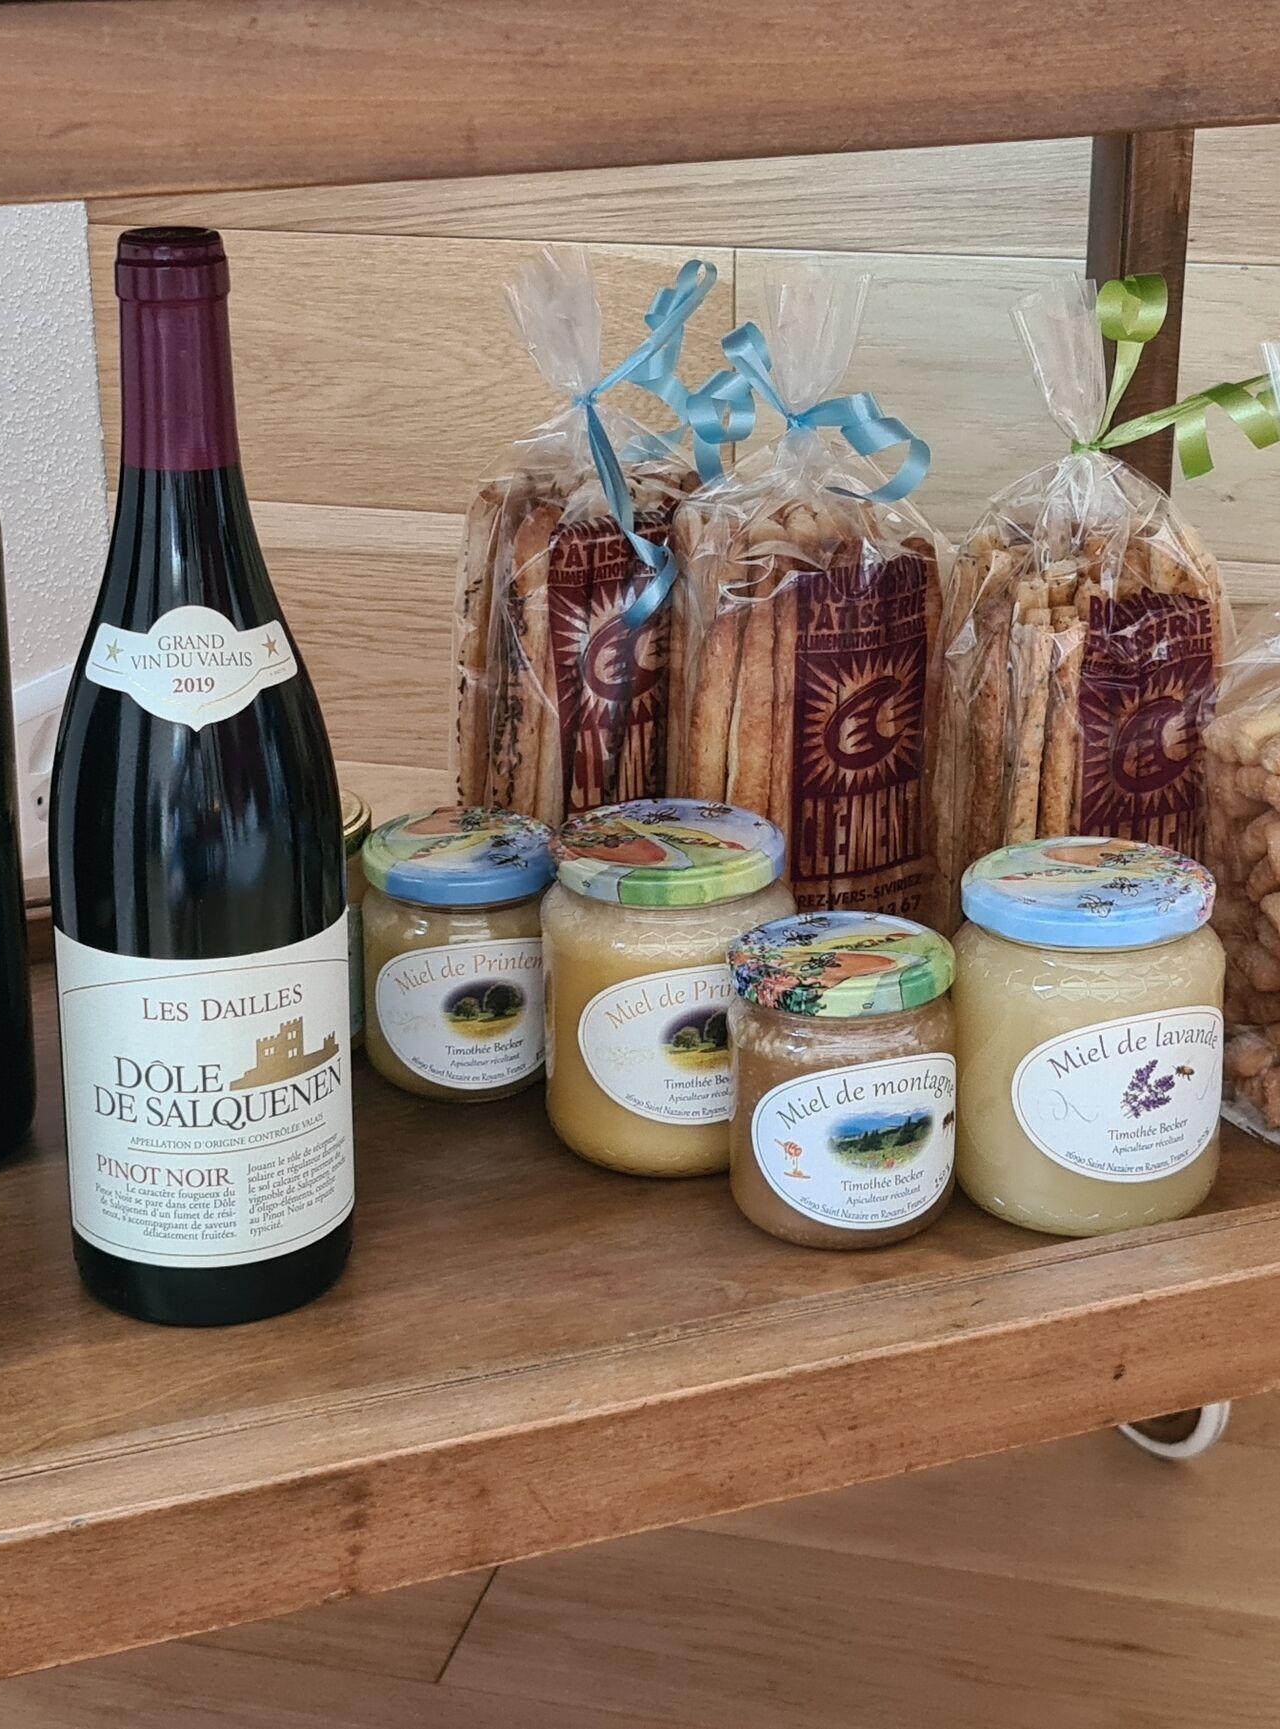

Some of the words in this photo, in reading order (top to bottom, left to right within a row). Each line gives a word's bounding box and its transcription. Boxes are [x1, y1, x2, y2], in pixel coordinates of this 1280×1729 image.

[158, 634, 225, 651] GRAND
[131, 654, 162, 670] VIN
[166, 653, 192, 668] DU
[194, 651, 253, 667] VALAIS
[172, 677, 215, 694] 2019
[393, 960, 435, 996] Miel
[441, 956, 465, 978] de
[474, 952, 543, 973] Printem
[141, 997, 190, 1022] LES
[201, 983, 303, 1022] DAILLES
[604, 989, 654, 1029] Miel
[659, 983, 685, 1008] de
[445, 1043, 491, 1056] Timothée
[494, 1038, 524, 1052] Becker
[1047, 1035, 1109, 1079] Miel
[1117, 1028, 1147, 1055] de
[1156, 1020, 1218, 1050] lavande
[113, 1056, 225, 1094] DÔLE
[664, 1076, 712, 1089] Timothée
[93, 1083, 138, 1123] DE
[145, 1057, 343, 1131] SALQUENEN
[668, 1092, 711, 1104] Apiculteur
[776, 1086, 831, 1130] Miel
[836, 1079, 865, 1105] de
[872, 1069, 954, 1099] montagne
[645, 1101, 663, 1113] Saint
[130, 1136, 191, 1149] APPELLATION
[194, 1137, 247, 1149] D'ORIGINE
[248, 1124, 301, 1143] CONTRÔLÉE
[1107, 1126, 1157, 1140] Timothée
[1160, 1118, 1188, 1134] Becker
[1112, 1142, 1154, 1155] Apiculteur
[1155, 1134, 1184, 1148] récoltant
[246, 1161, 276, 1175] Jouant
[278, 1157, 285, 1166] le
[287, 1151, 301, 1163] rôle
[303, 1146, 311, 1157] de
[1086, 1158, 1105, 1167] Saint
[1106, 1162, 1134, 1173] Nazaire
[96, 1153, 161, 1185] PINOT
[166, 1167, 234, 1188] NOIR
[247, 1170, 275, 1183] solaire
[277, 1168, 285, 1176] et
[248, 1183, 256, 1194] le
[258, 1181, 270, 1192] sol
[273, 1174, 301, 1189] calcaire
[841, 1177, 892, 1192] Timothée
[895, 1169, 925, 1186] Becker
[126, 1183, 135, 1193] Le
[138, 1186, 176, 1198] caractère
[178, 1186, 220, 1201] fougueux
[223, 1187, 235, 1196] du
[248, 1186, 284, 1206] vignoble
[286, 1184, 295, 1194] de
[846, 1194, 888, 1207] Apiculteur
[890, 1185, 921, 1200] récoltant
[145, 1199, 163, 1209] pare
[166, 1199, 186, 1209] dans
[189, 1200, 211, 1209] cette
[213, 1199, 236, 1209] Dôle
[150, 1207, 171, 1218] d'un
[173, 1208, 200, 1219] fumet
[203, 1208, 214, 1219] de
[217, 1208, 236, 1219] rési-
[262, 1210, 285, 1222] Pinot
[288, 1203, 305, 1215] Noir
[821, 1204, 839, 1217] Saint
[841, 1209, 869, 1220] Nazaire
[142, 1228, 198, 1240] délicatement
[201, 1230, 237, 1240] fruitées.
[191, 1220, 202, 1230] de
[205, 1221, 237, 1230] saveurs
[250, 1220, 283, 1237] typicité.
